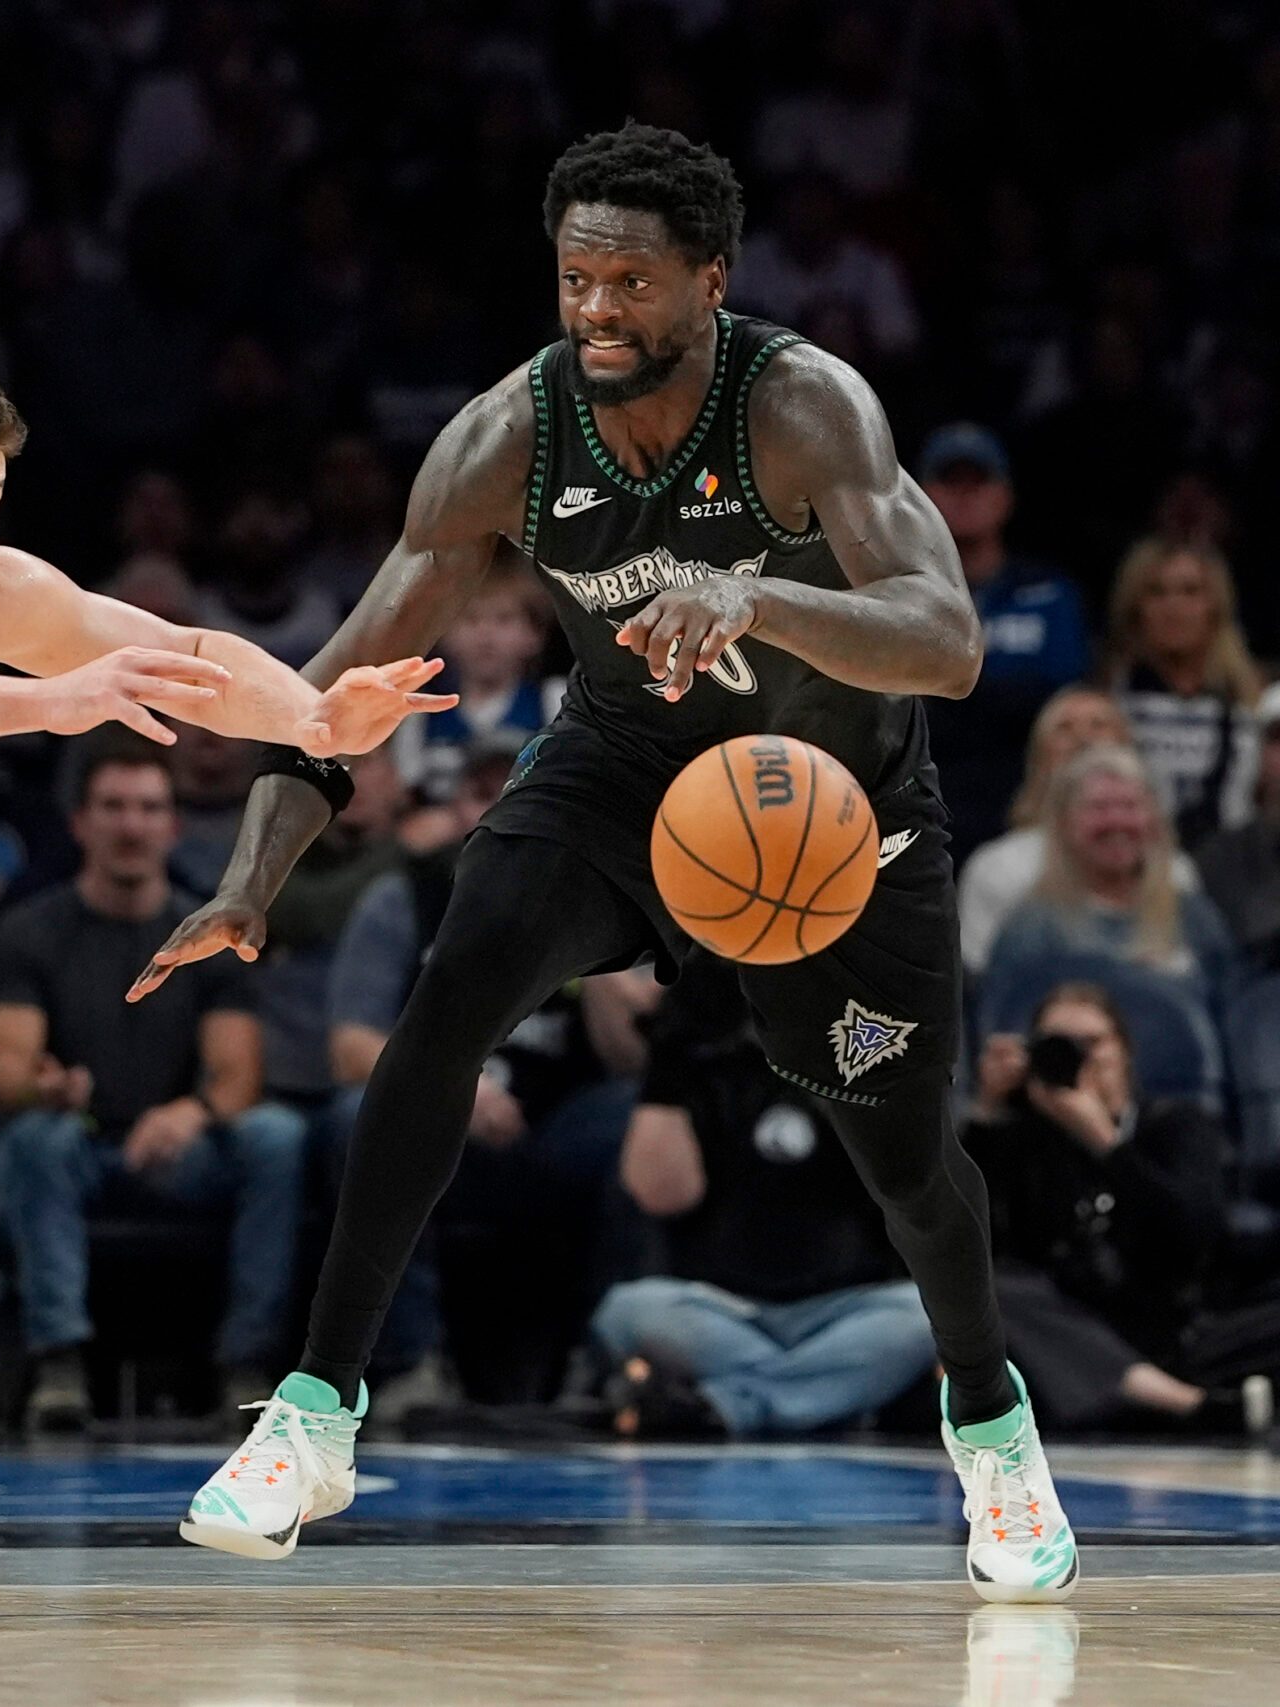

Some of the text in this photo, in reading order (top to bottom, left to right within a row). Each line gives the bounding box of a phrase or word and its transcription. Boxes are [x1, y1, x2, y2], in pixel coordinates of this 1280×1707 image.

[561, 487, 598, 506] NIKE
[679, 497, 743, 520] sezzle
[880, 829, 912, 856] NIKE
